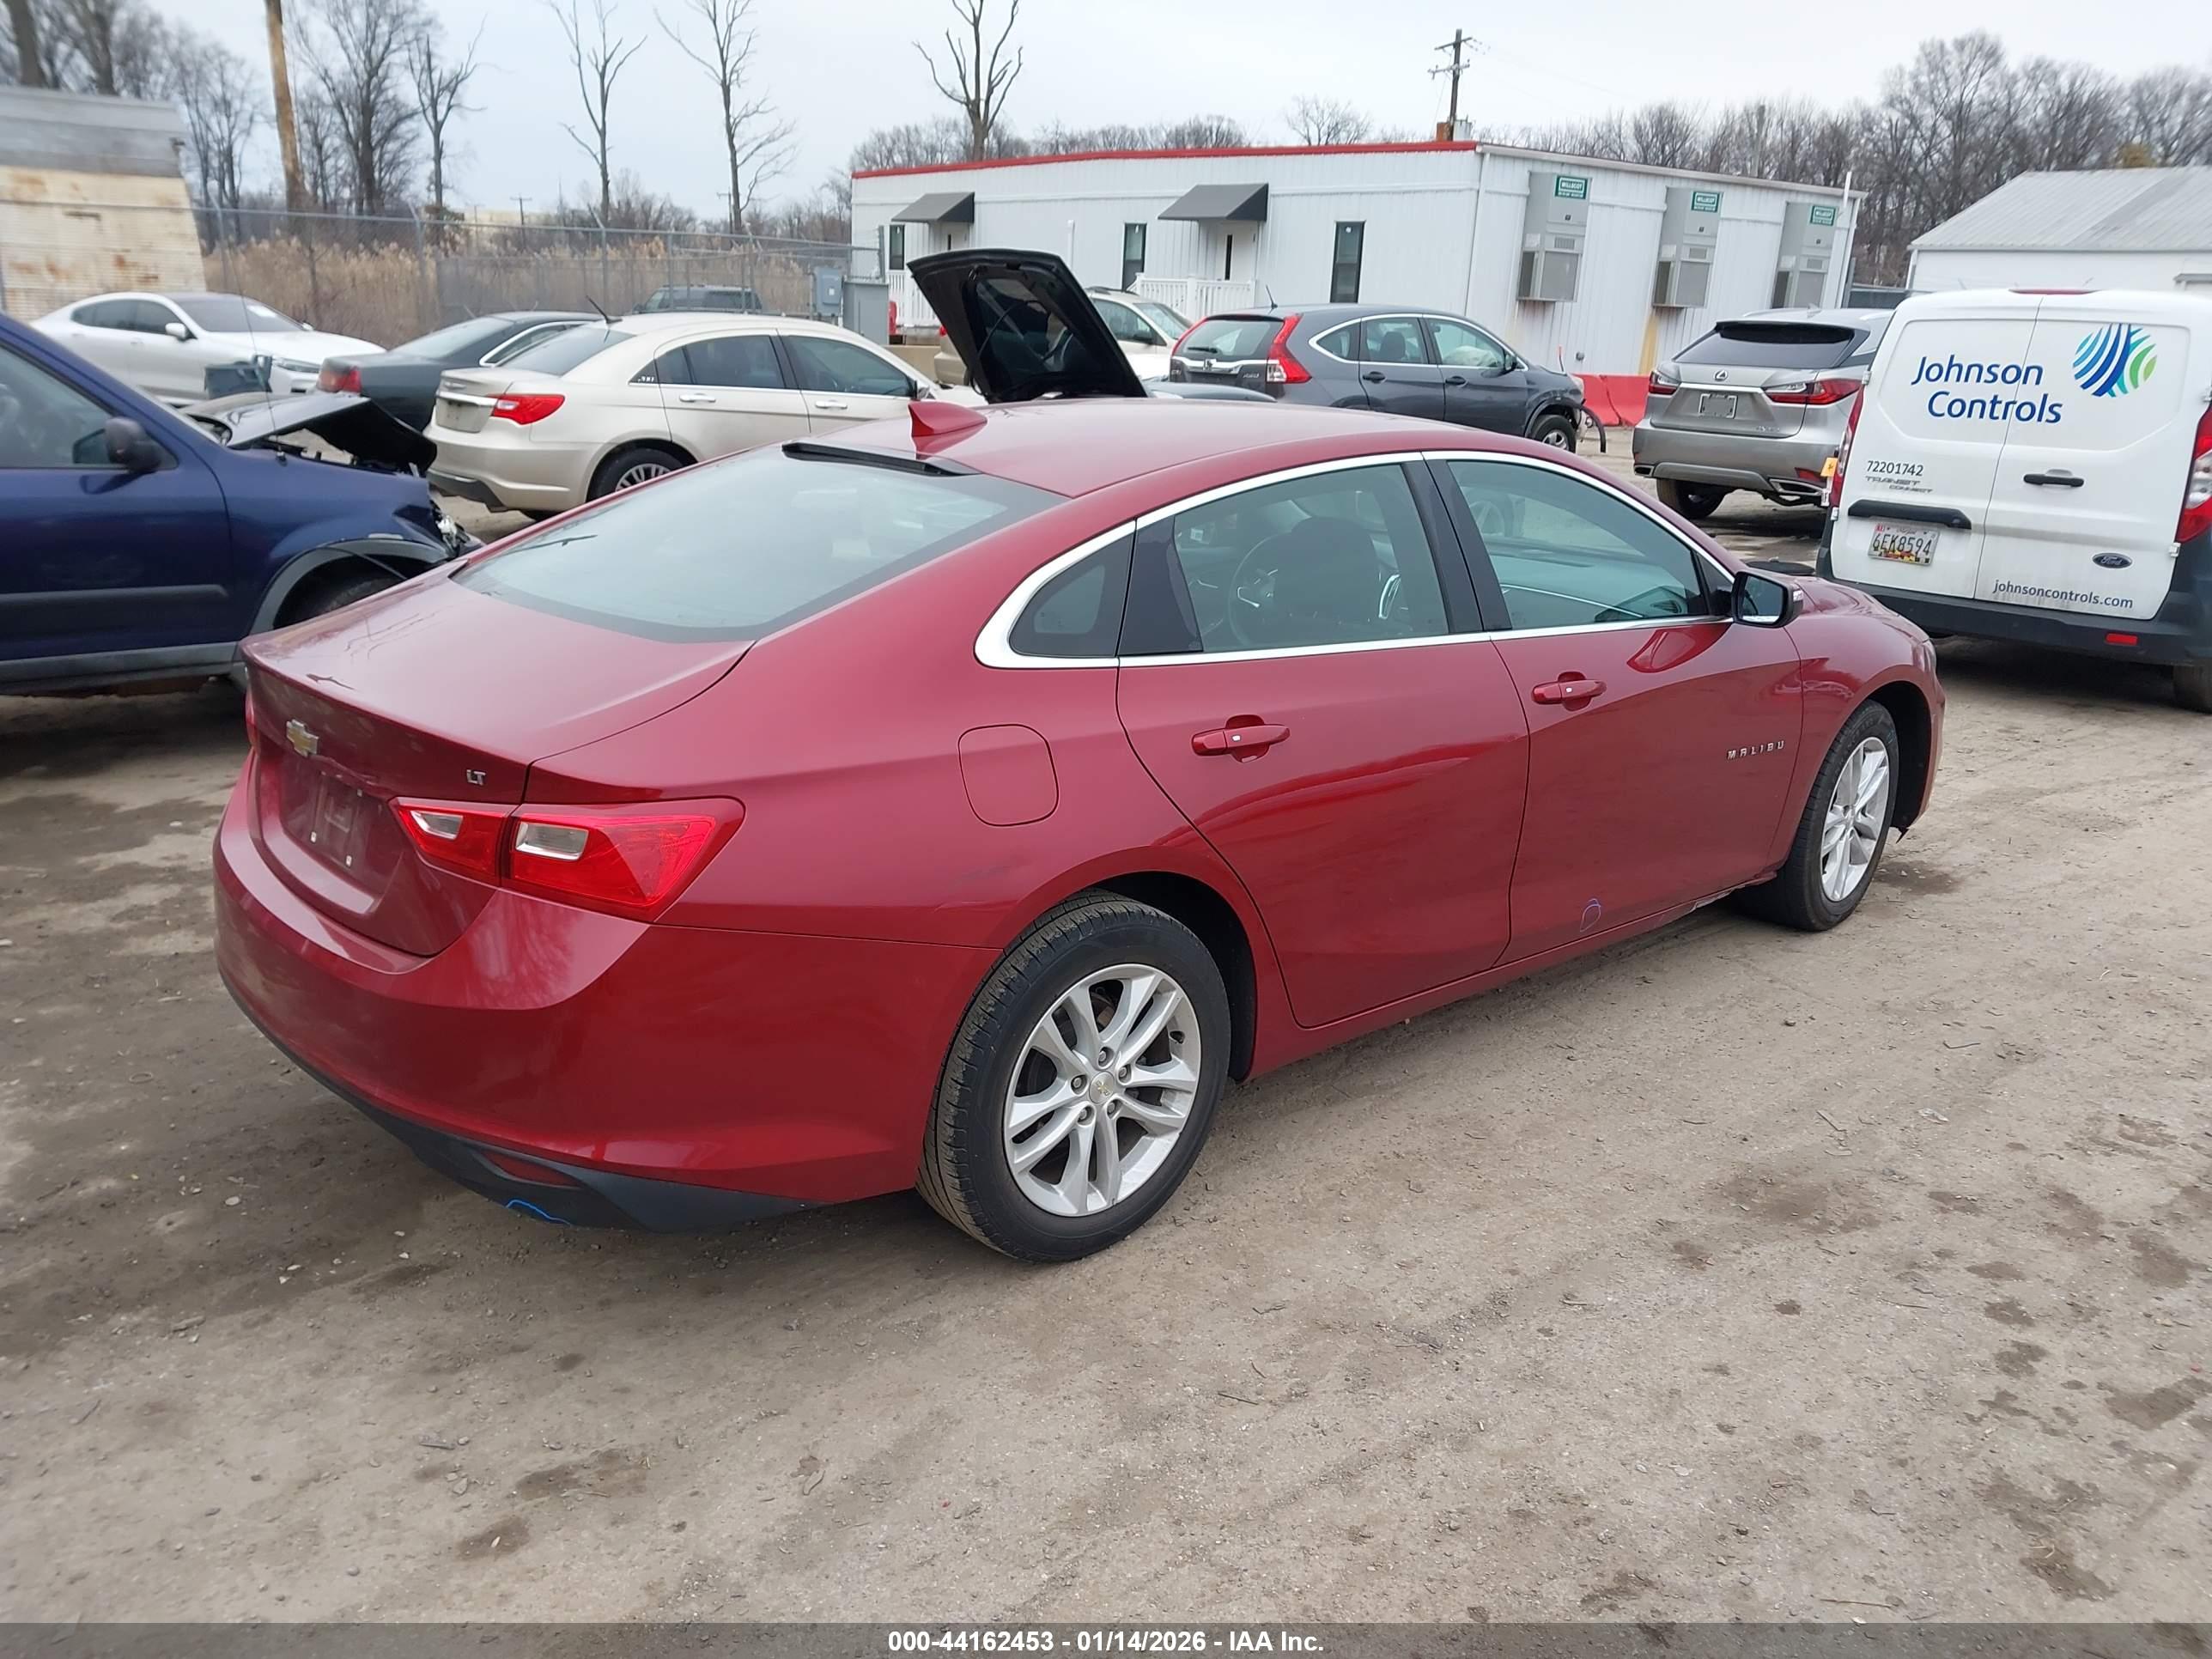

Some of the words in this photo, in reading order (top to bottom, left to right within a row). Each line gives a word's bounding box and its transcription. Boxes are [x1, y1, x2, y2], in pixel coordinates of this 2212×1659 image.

[1911, 354, 2044, 386] Johnson
[1927, 391, 2063, 423] Controls
[1867, 459, 1923, 477] 72201742
[1872, 532, 1932, 557] 6EK8594
[1992, 580, 2134, 609] johnsoncontrols.com
[1726, 740, 1785, 760] MALIBU
[466, 769, 486, 786] LT
